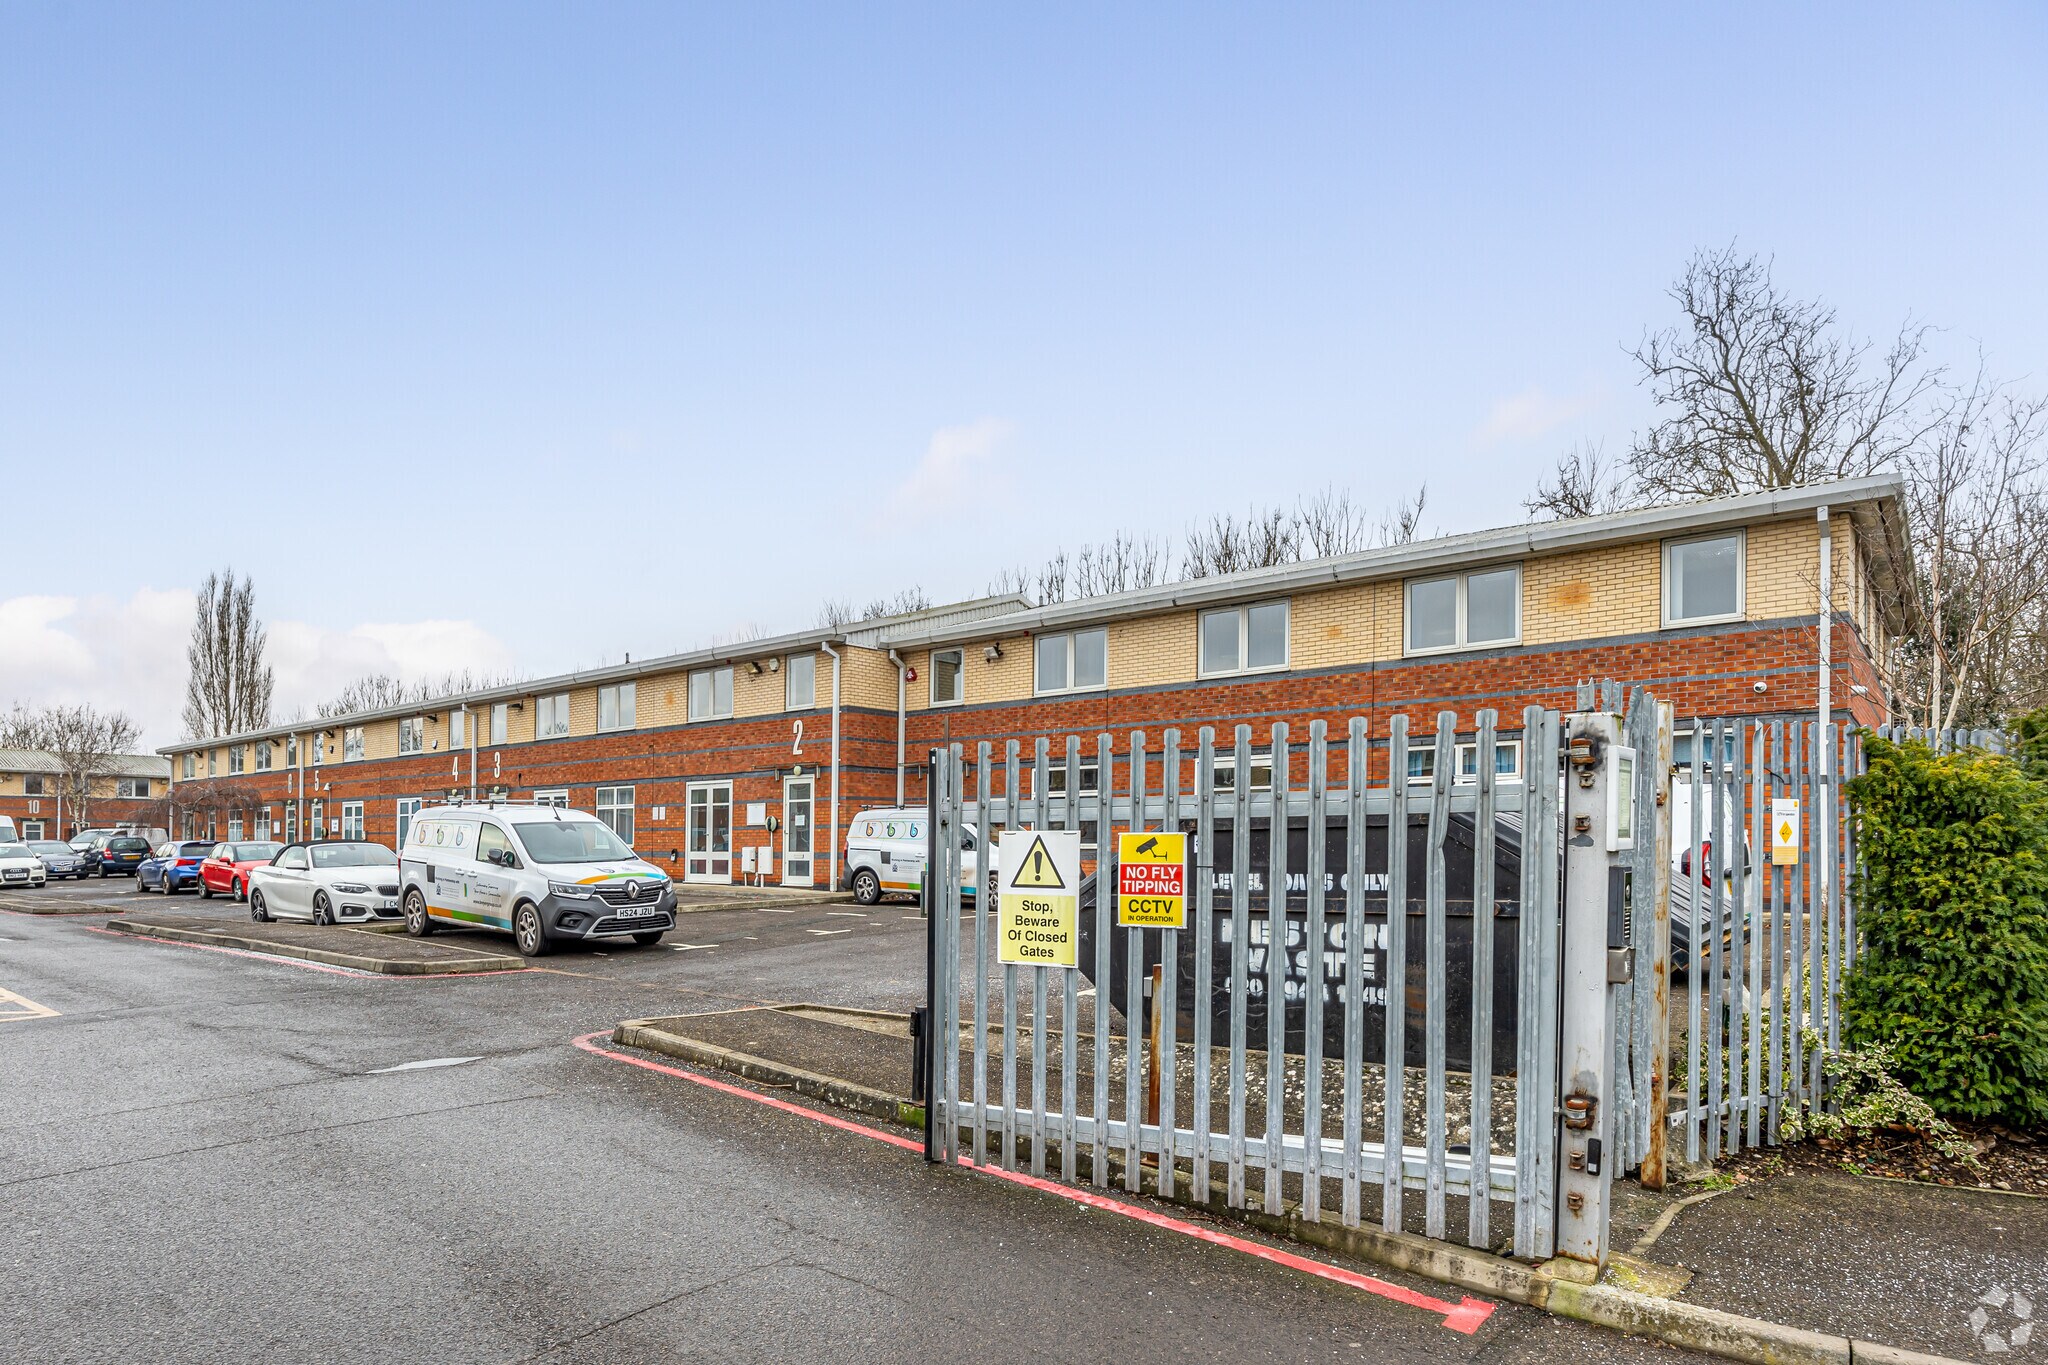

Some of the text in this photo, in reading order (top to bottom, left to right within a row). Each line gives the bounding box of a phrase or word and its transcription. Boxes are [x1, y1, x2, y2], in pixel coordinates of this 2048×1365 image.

[793, 719, 803, 755] 2
[452, 756, 459, 782] 4
[494, 751, 501, 778] 3
[314, 770, 320, 791] 5
[27, 799, 40, 814] 10
[1126, 866, 1178, 880] NO FLY
[1123, 880, 1181, 894] TIPPING
[619, 907, 653, 918] HS24 JZU
[1022, 900, 1053, 914] Stop,
[1128, 899, 1173, 914] CCTV
[1015, 915, 1059, 928] Beware
[1008, 929, 1067, 943] Of Closed
[1019, 945, 1055, 958] Gates
